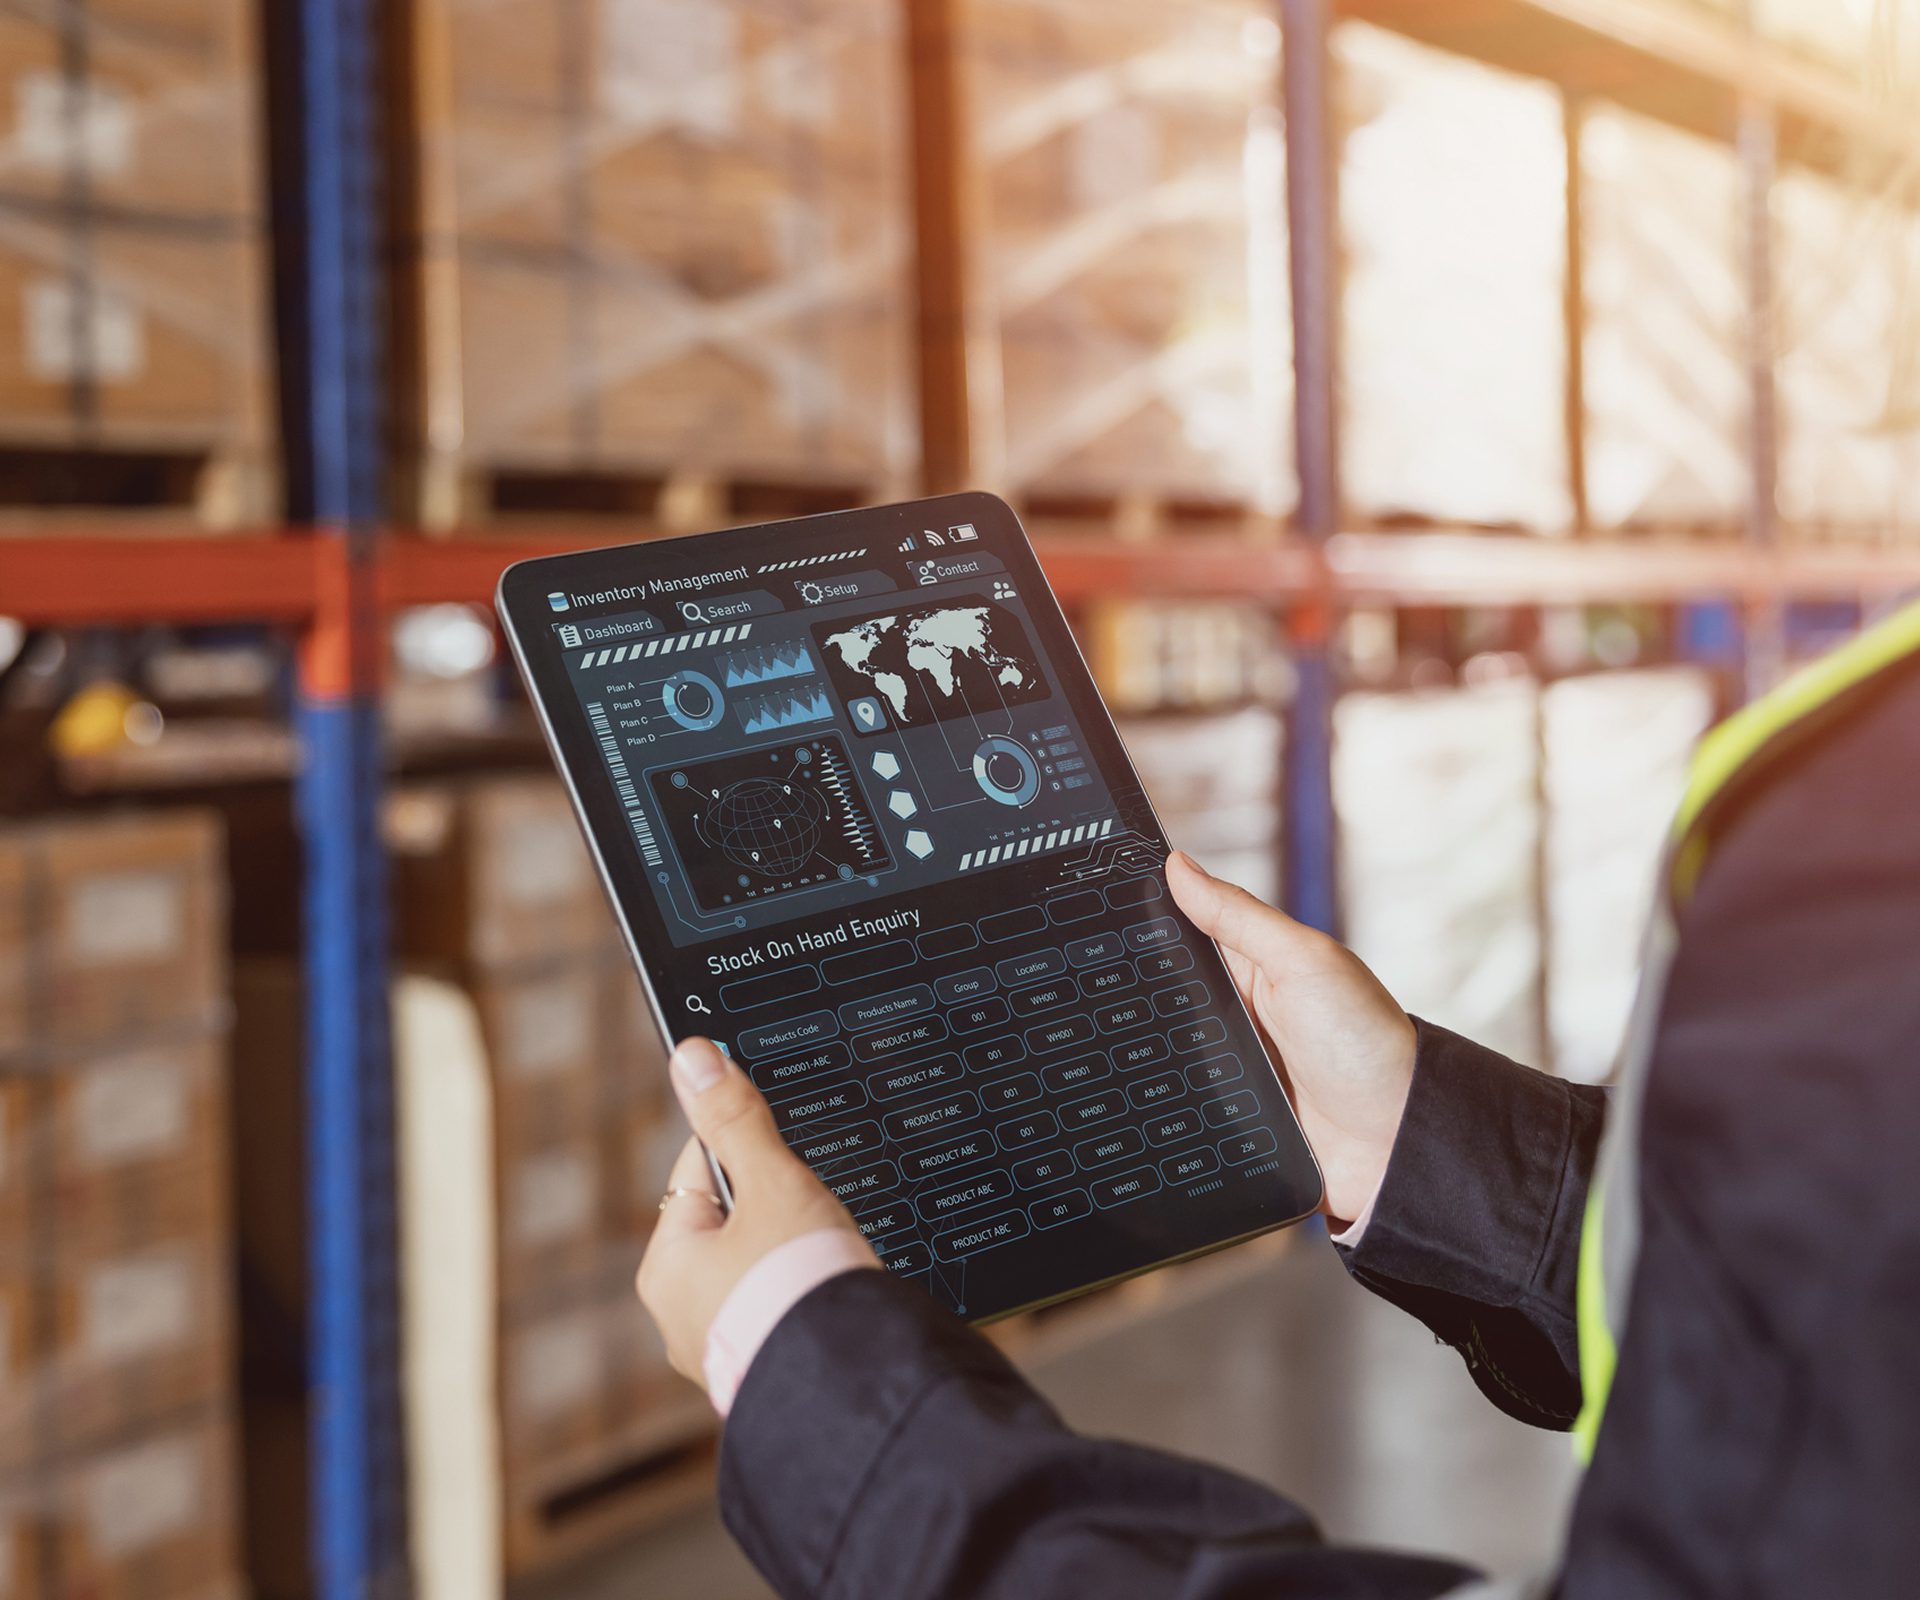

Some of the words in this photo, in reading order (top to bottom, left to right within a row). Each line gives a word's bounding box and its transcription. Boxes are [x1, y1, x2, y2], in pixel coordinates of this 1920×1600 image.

[936, 560, 980, 577] Contact
[571, 584, 646, 608] Inventory
[649, 565, 750, 595] Management
[823, 583, 859, 598] Setup
[707, 601, 752, 618] Search
[584, 617, 654, 641] Dashboard
[606, 682, 626, 694] Plan
[627, 682, 636, 691] A
[613, 699, 632, 711] Plan
[633, 699, 642, 708] B
[620, 717, 639, 729] Plan
[641, 716, 649, 725] C
[627, 734, 647, 747] Plan
[648, 734, 656, 743] D
[707, 947, 766, 975] Stock
[766, 940, 795, 960] On
[797, 923, 848, 953] Hand
[850, 908, 921, 939] Enquiry
[1136, 928, 1169, 943] Quantity
[1084, 943, 1105, 957] Shelf
[1014, 961, 1049, 977] Location
[1157, 957, 1174, 970] 256
[953, 980, 980, 993] Group
[1095, 972, 1122, 988] AB-001
[1029, 990, 1059, 1006] WH001
[1173, 993, 1190, 1006] 256
[857, 1003, 895, 1020] Products
[894, 997, 918, 1011] Name
[970, 1010, 987, 1023] 001
[1111, 1009, 1138, 1025] AB-001
[759, 1030, 797, 1048] Products
[796, 1024, 820, 1039] Code
[870, 1031, 912, 1052] PRODUCT
[912, 1026, 931, 1040] ABC
[1045, 1027, 1075, 1043] WH001
[1190, 1029, 1206, 1042] 256
[986, 1048, 1003, 1061] 001
[1127, 1045, 1154, 1062] AB-001
[773, 1054, 832, 1079] PRD0001-ABC
[1061, 1065, 1091, 1081] WH001
[1206, 1066, 1223, 1079] 256
[886, 1070, 928, 1091] PRODUCT
[928, 1064, 946, 1079] ABC
[1002, 1086, 1019, 1100] 001
[1143, 1083, 1171, 1099] AB-001
[789, 1093, 848, 1120] PRD0001-ABC
[1077, 1103, 1108, 1119] WH001
[1223, 1103, 1240, 1116] 256
[902, 1109, 944, 1130] PRODUCT
[944, 1103, 963, 1118] ABC
[1019, 1125, 1036, 1138] 001
[1160, 1120, 1188, 1137] AB-001
[804, 1133, 864, 1160] PRD0001-ABC
[1094, 1141, 1124, 1158] WH001
[1240, 1140, 1257, 1153] 256
[919, 1148, 960, 1170] PRODUCT
[960, 1142, 979, 1157] ABC
[1035, 1164, 1052, 1177] 001
[1177, 1158, 1204, 1175] AB-001
[830, 1174, 880, 1197] D0001-ABC
[1111, 1179, 1141, 1196] WH001
[936, 1188, 977, 1210] PRODUCT
[976, 1182, 995, 1197] ABC
[1052, 1203, 1069, 1217] 001
[858, 1215, 896, 1236] 001-ABC
[952, 1228, 993, 1250] PRODUCT
[993, 1222, 1012, 1237] ABC
